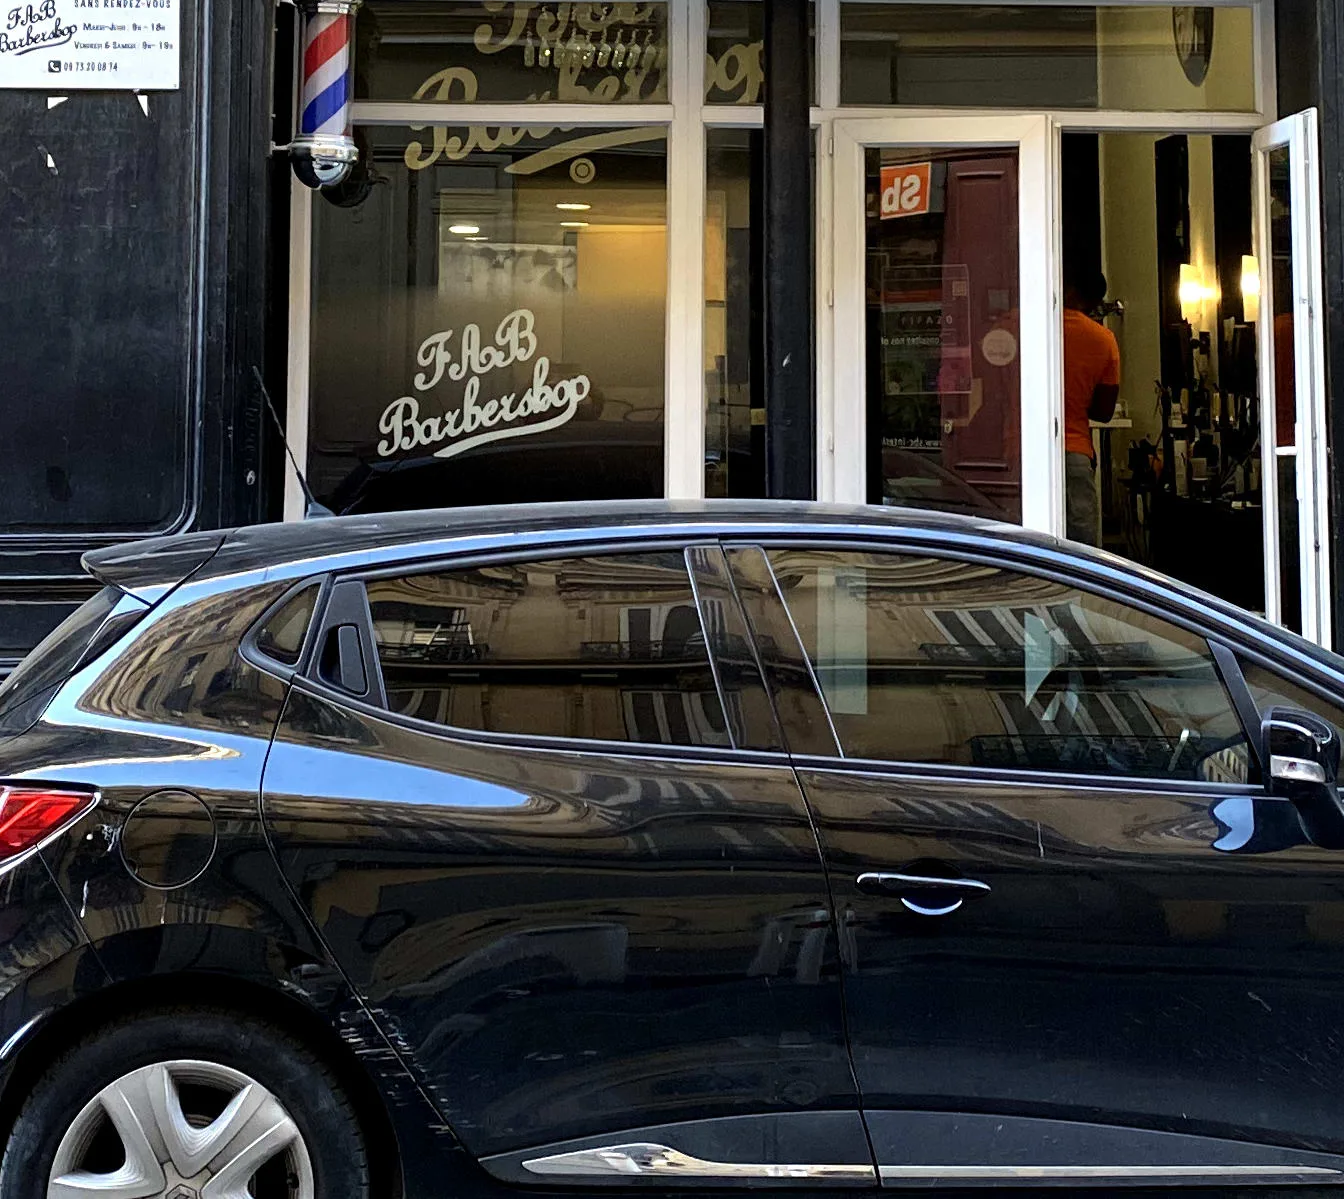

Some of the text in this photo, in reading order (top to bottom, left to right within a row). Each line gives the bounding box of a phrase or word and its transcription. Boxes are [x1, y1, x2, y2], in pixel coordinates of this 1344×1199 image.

[74, 0, 171, 9] SANS RENDEZ-VOUS
[414, 309, 537, 390] FAB
[377, 356, 590, 457] Barbershop
